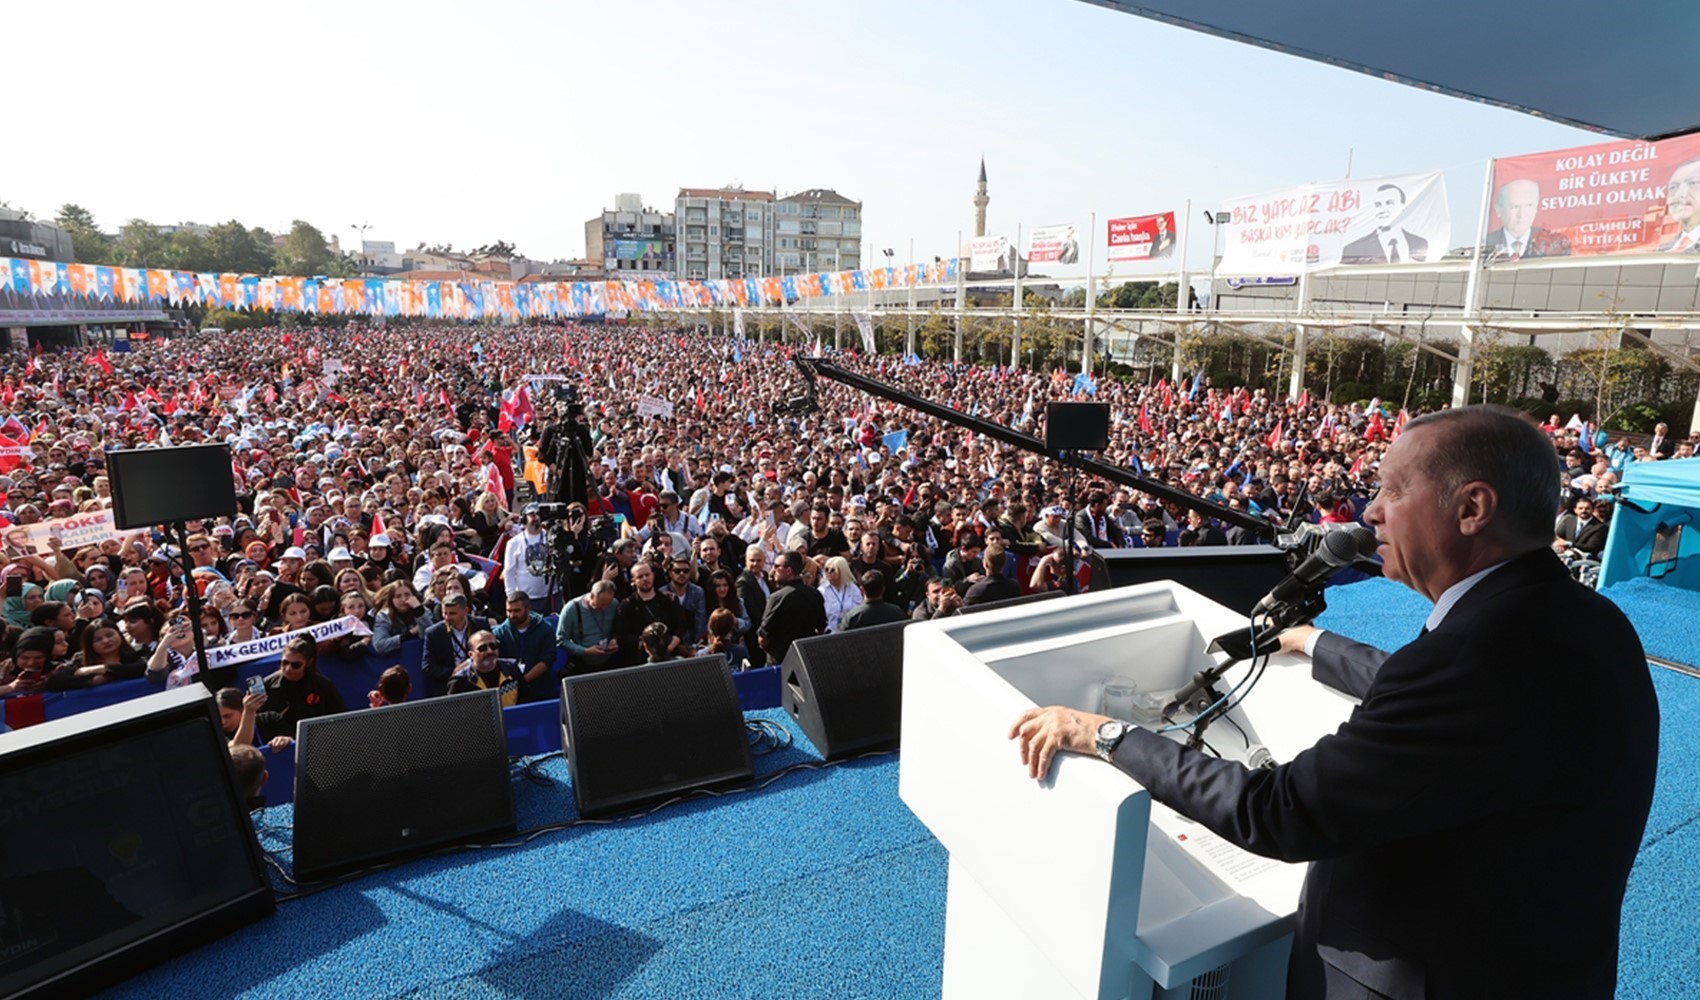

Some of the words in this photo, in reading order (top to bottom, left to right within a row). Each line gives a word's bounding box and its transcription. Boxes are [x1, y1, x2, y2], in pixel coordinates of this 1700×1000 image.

[1555, 153, 1606, 172] KOLAY
[1608, 142, 1659, 165] DEĞİL
[1559, 173, 1585, 191] BİR
[1589, 168, 1650, 187] ÜLKEYE
[1262, 194, 1320, 224] YAPCAZ
[1327, 189, 1360, 213] ABİ
[1541, 192, 1601, 211] SEVDALI
[1606, 186, 1667, 204] OLMAK
[1580, 219, 1642, 233] CUMHUR
[1582, 232, 1637, 245] İTTİFAKI
[0, 446, 21, 454] YDIN
[63, 531, 114, 547] OLLARI
[215, 650, 237, 663] AK
[310, 622, 343, 638] YDIN
[0, 938, 38, 959] YDIN
